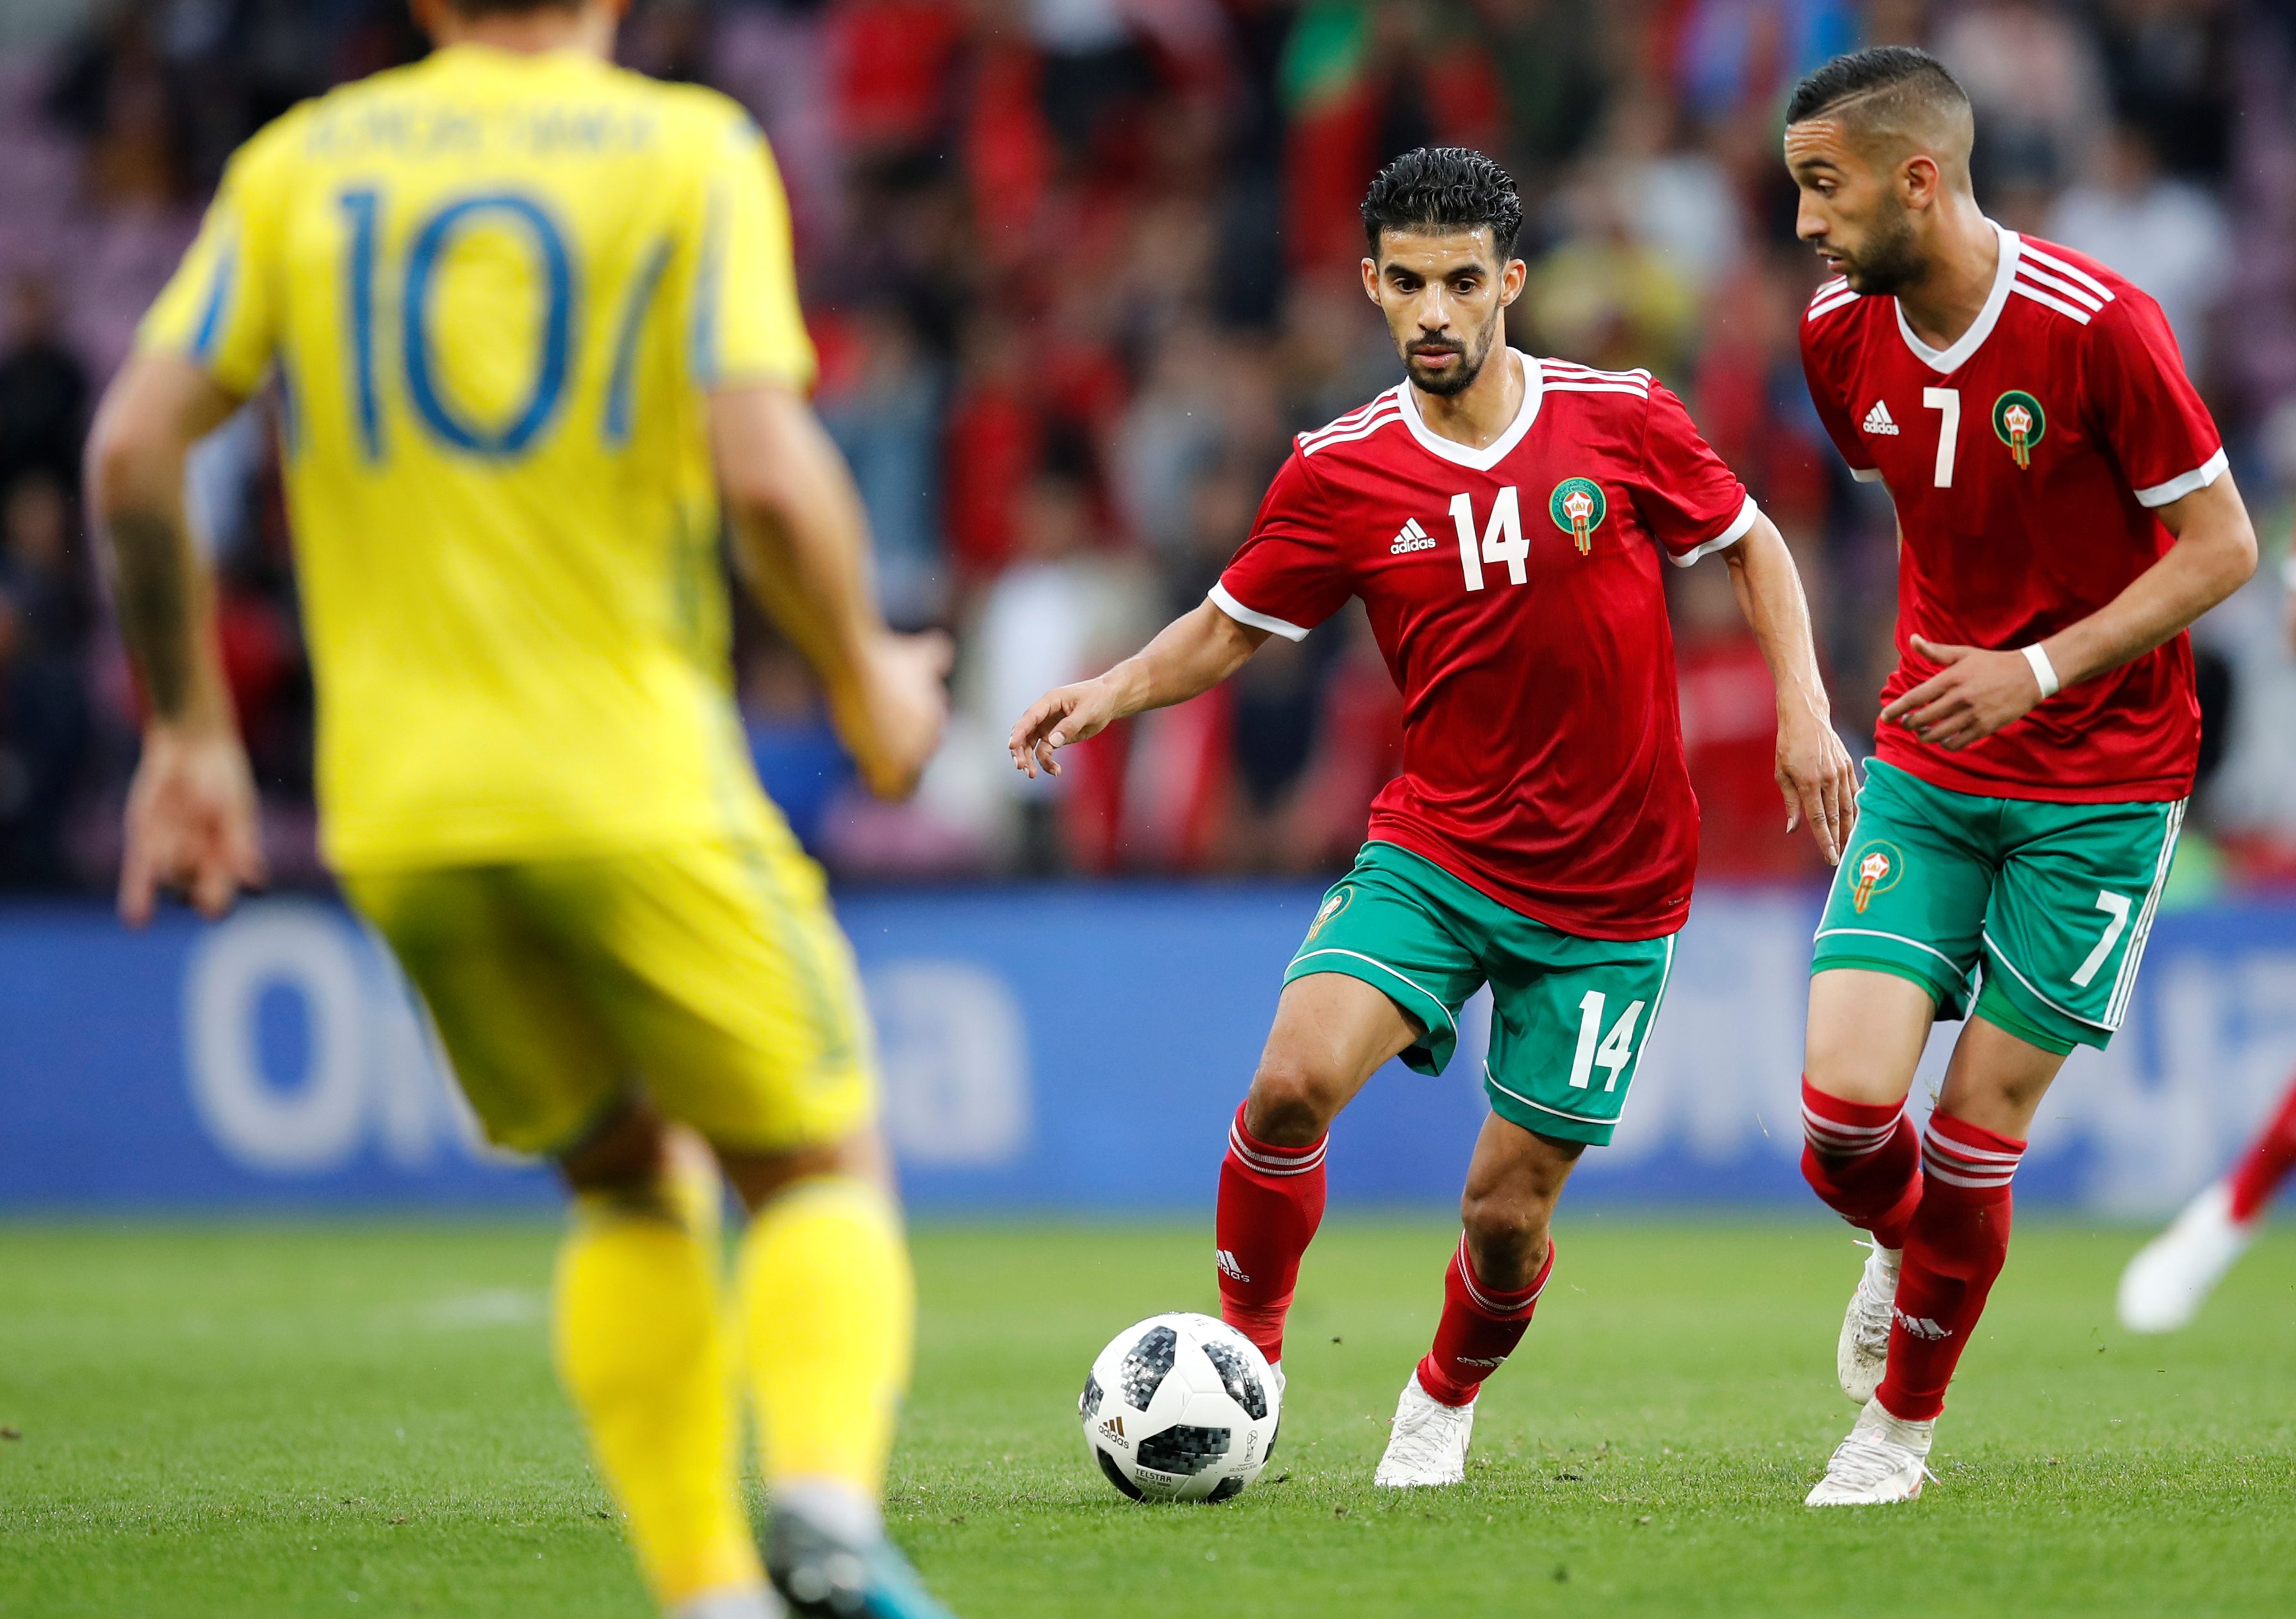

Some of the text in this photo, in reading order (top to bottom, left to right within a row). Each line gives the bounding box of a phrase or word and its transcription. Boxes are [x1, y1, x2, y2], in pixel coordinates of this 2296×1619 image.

[338, 186, 575, 456] 10
[1863, 419, 1899, 436] adidas
[1923, 387, 1960, 488] 7
[1390, 536, 1436, 555] adidas
[1448, 486, 1530, 591] 14
[2070, 889, 2131, 987] 7
[1569, 990, 1645, 1092] 14
[1098, 1426, 1129, 1449] adidas
